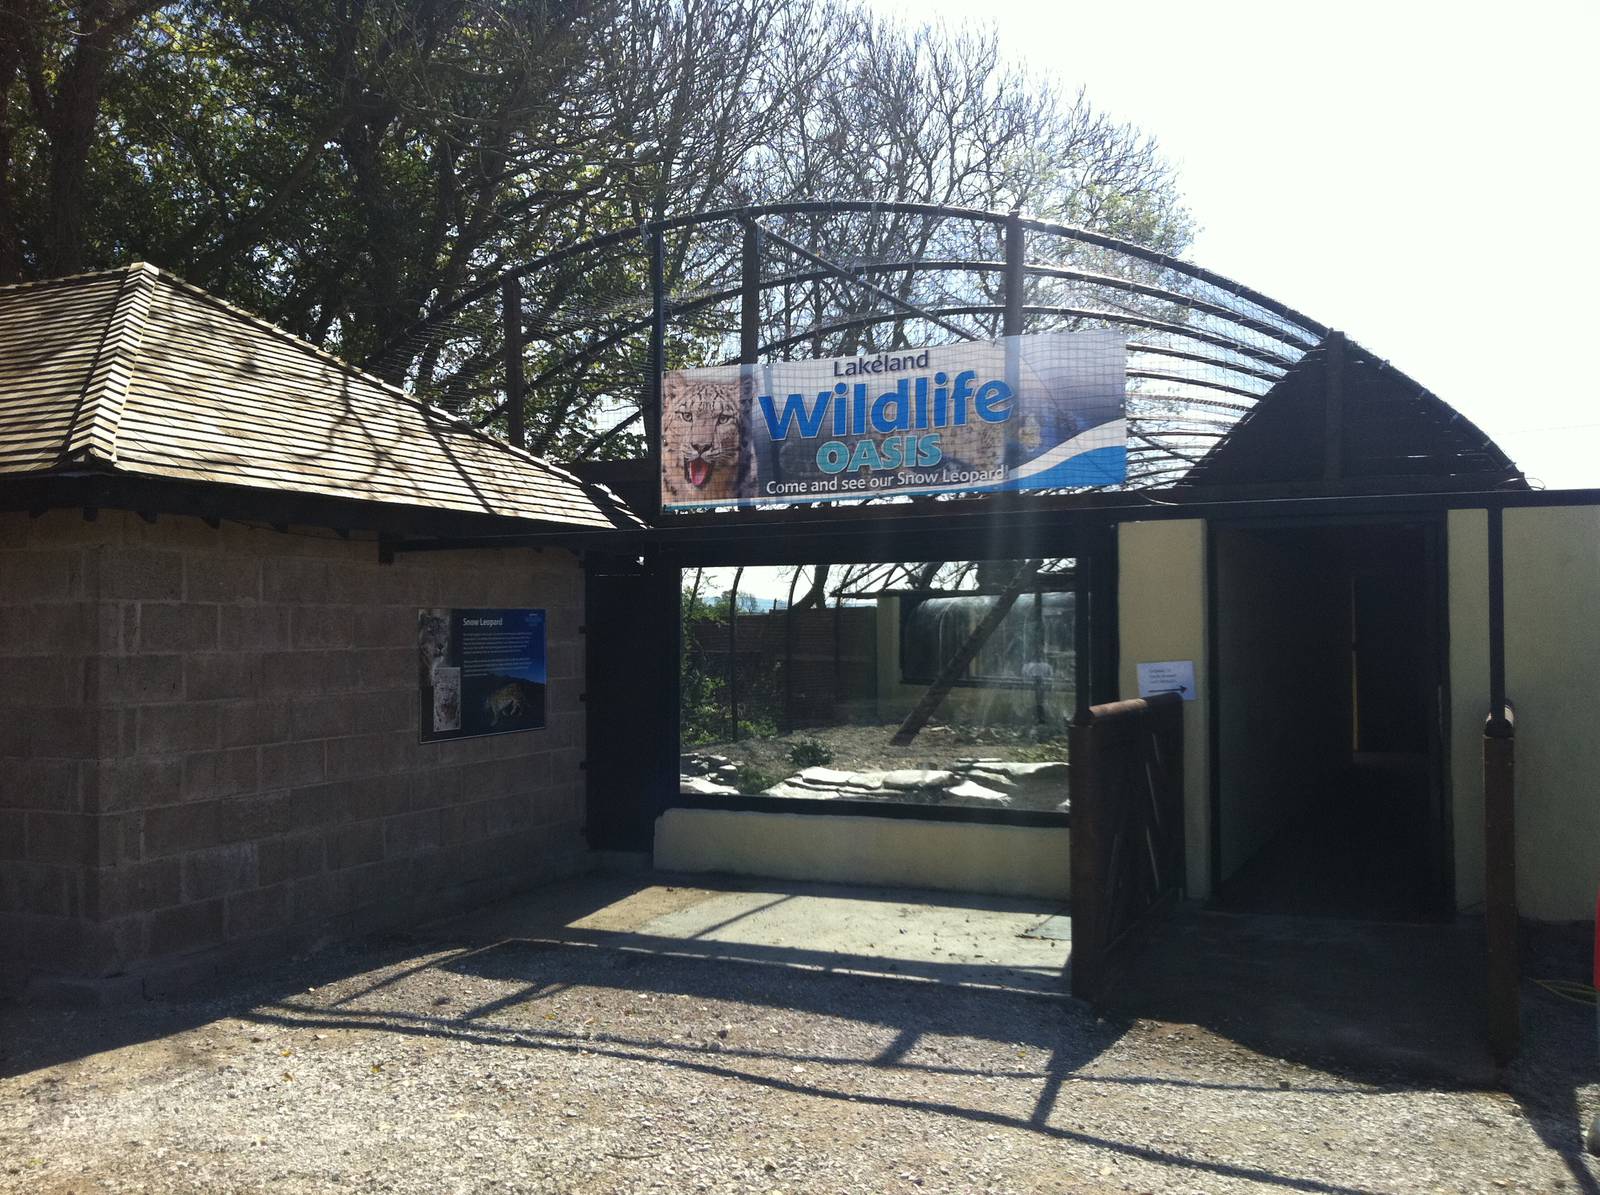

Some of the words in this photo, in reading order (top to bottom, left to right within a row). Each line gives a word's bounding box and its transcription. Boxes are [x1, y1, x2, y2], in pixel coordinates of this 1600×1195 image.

[833, 350, 929, 377] Lakeland
[758, 369, 1016, 441] Wildlife
[815, 433, 943, 474] OASIS
[766, 480, 808, 494] Come
[811, 476, 838, 492] and
[841, 479, 866, 490] see
[870, 475, 895, 488] our
[897, 471, 939, 486] Snow
[942, 464, 1009, 484] Leopard!
[463, 617, 479, 626] Snow
[480, 617, 503, 628] Leopard
